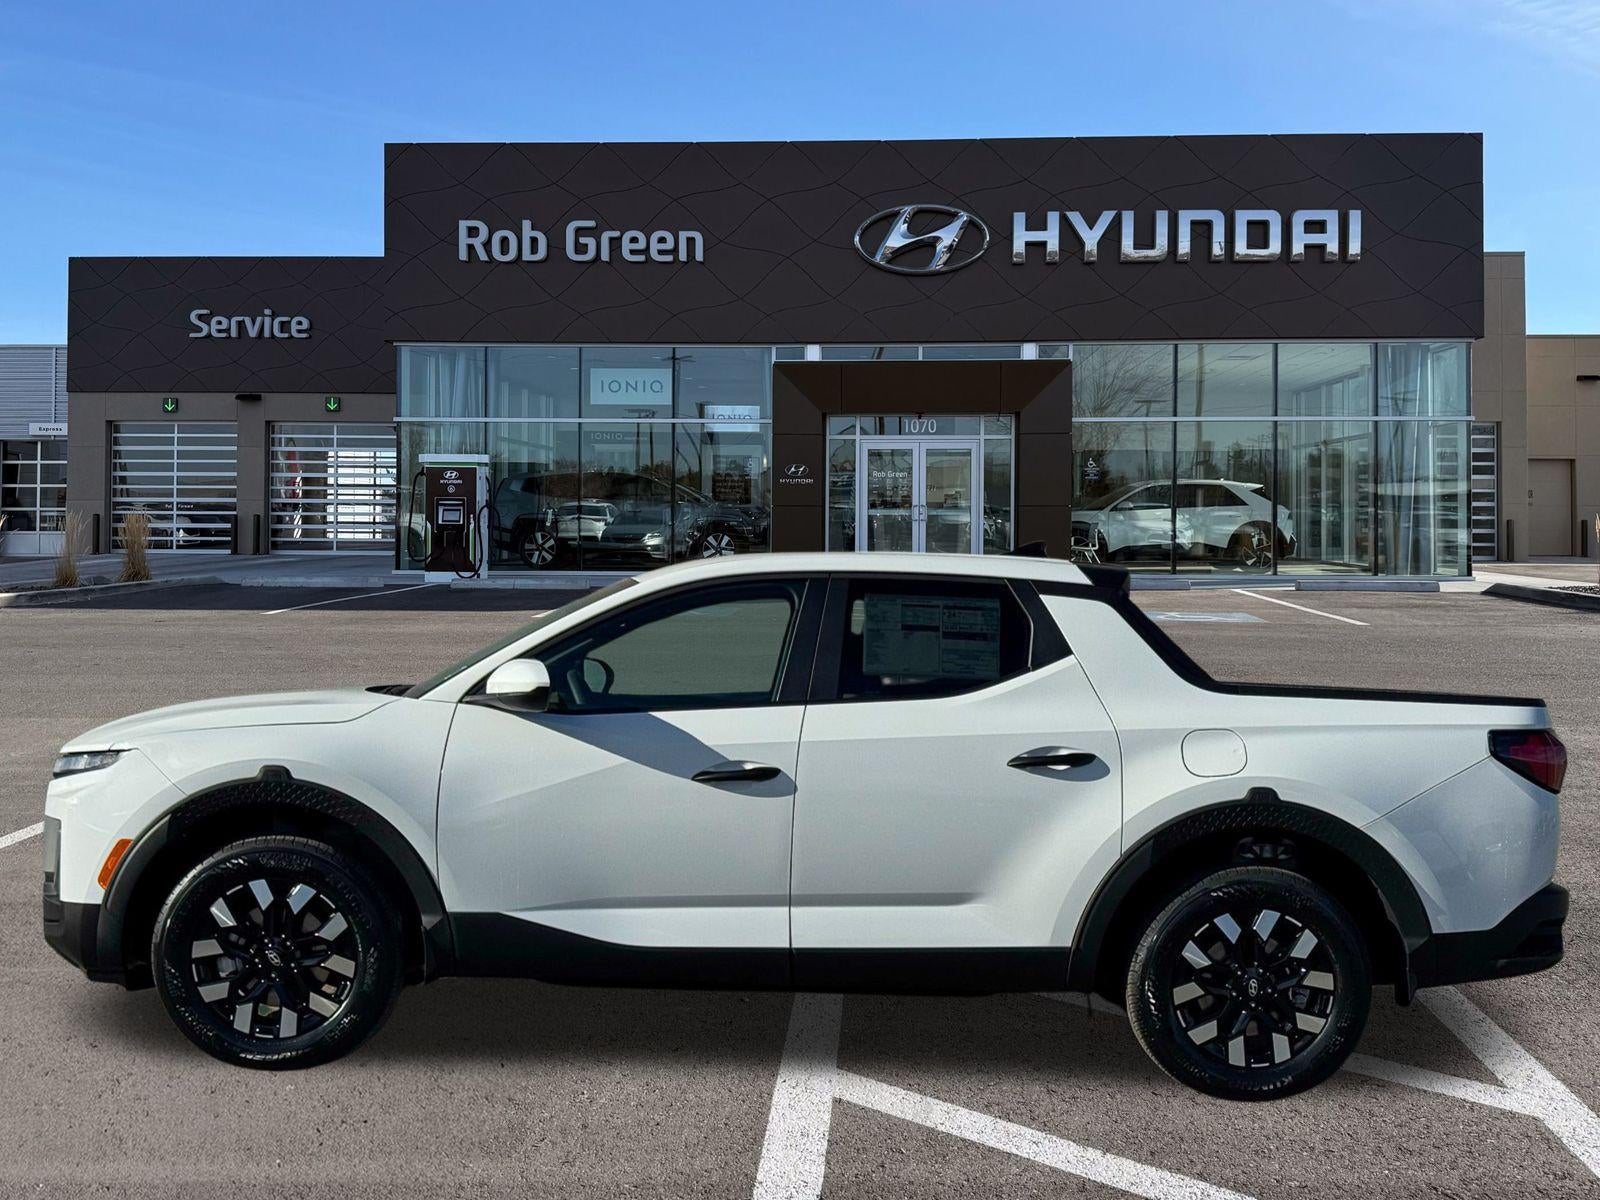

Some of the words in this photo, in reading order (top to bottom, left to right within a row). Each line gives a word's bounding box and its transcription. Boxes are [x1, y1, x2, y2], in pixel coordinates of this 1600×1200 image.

[458, 219, 549, 263] Rob
[565, 219, 705, 263] Green
[1011, 209, 1362, 264] HYUNDAI
[189, 308, 310, 339] Service
[600, 379, 664, 394] IONIQ
[903, 418, 937, 433] 1070
[591, 432, 623, 440] IONIQ
[872, 470, 886, 478] Rob
[887, 470, 908, 478] Green
